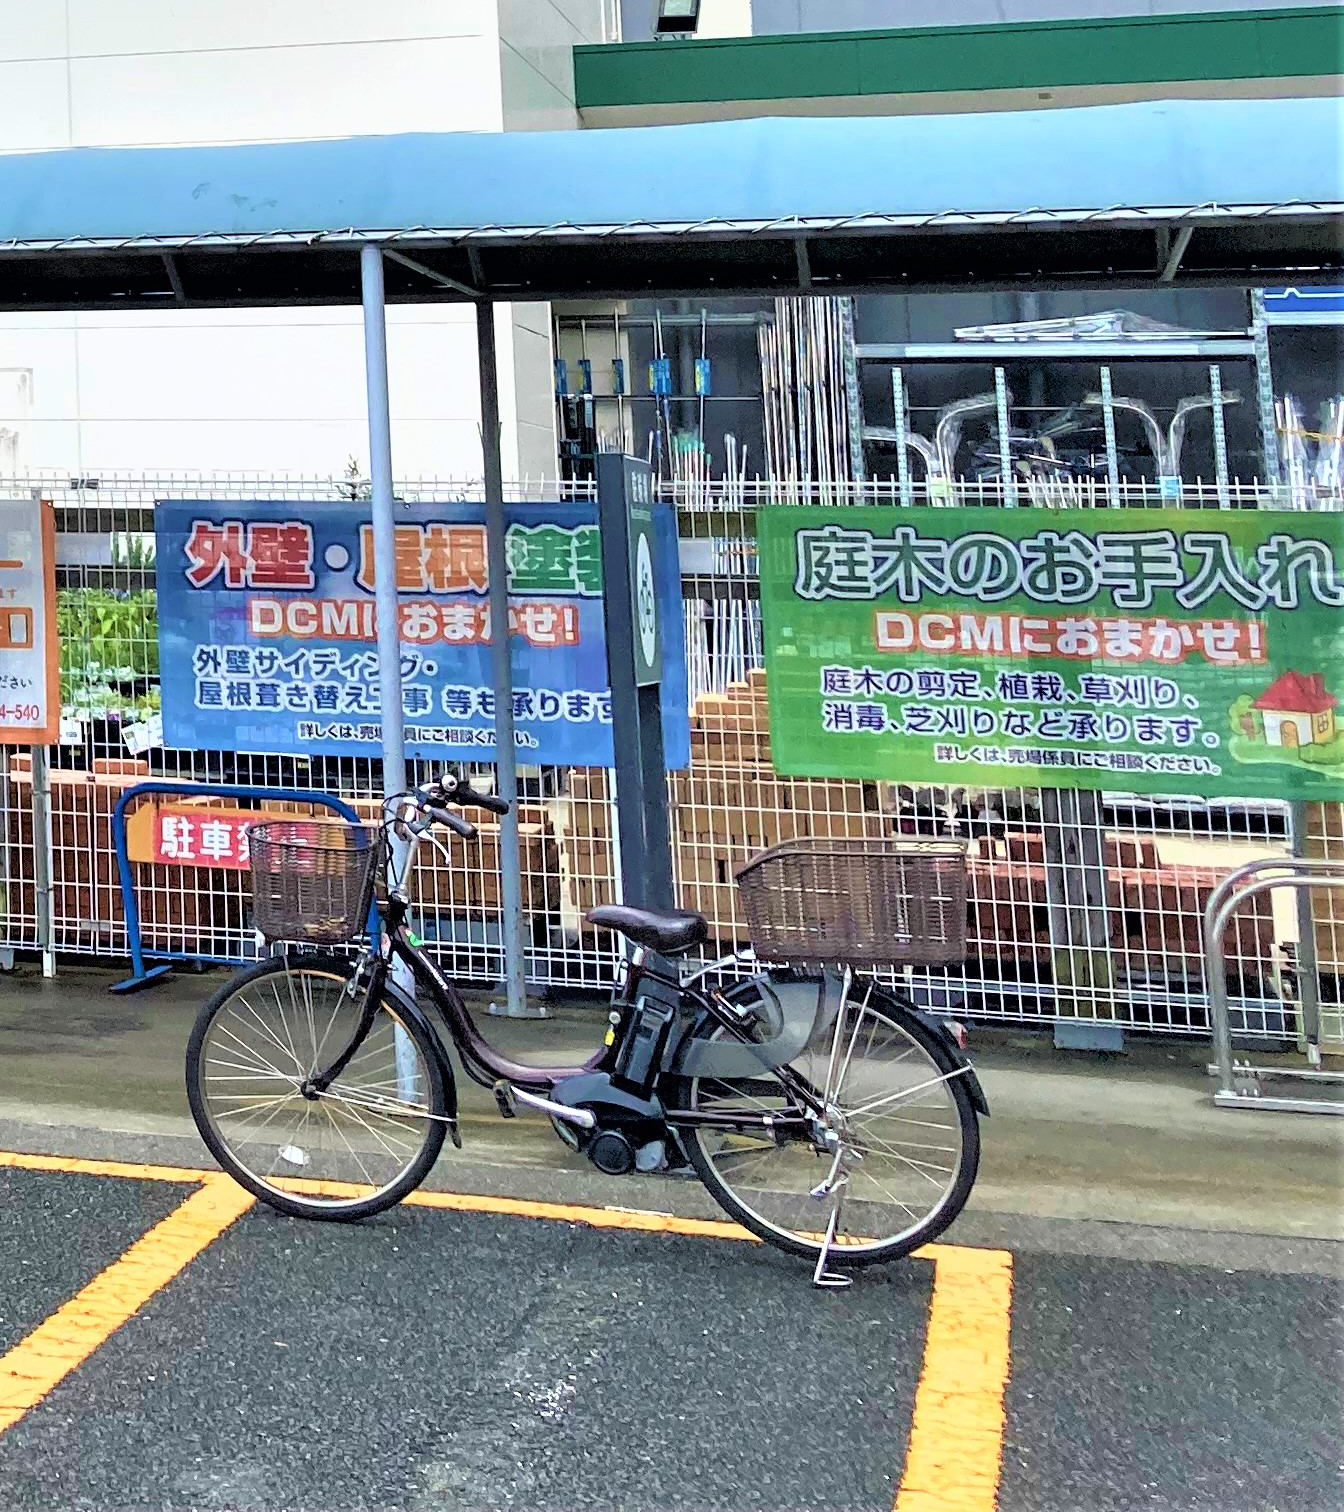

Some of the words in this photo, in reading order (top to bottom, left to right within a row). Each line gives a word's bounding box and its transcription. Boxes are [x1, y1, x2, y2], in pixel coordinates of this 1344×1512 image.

[795, 525, 1344, 611] 庭木のお手入れ
[876, 611, 1263, 661] DCMにおまかせ!
